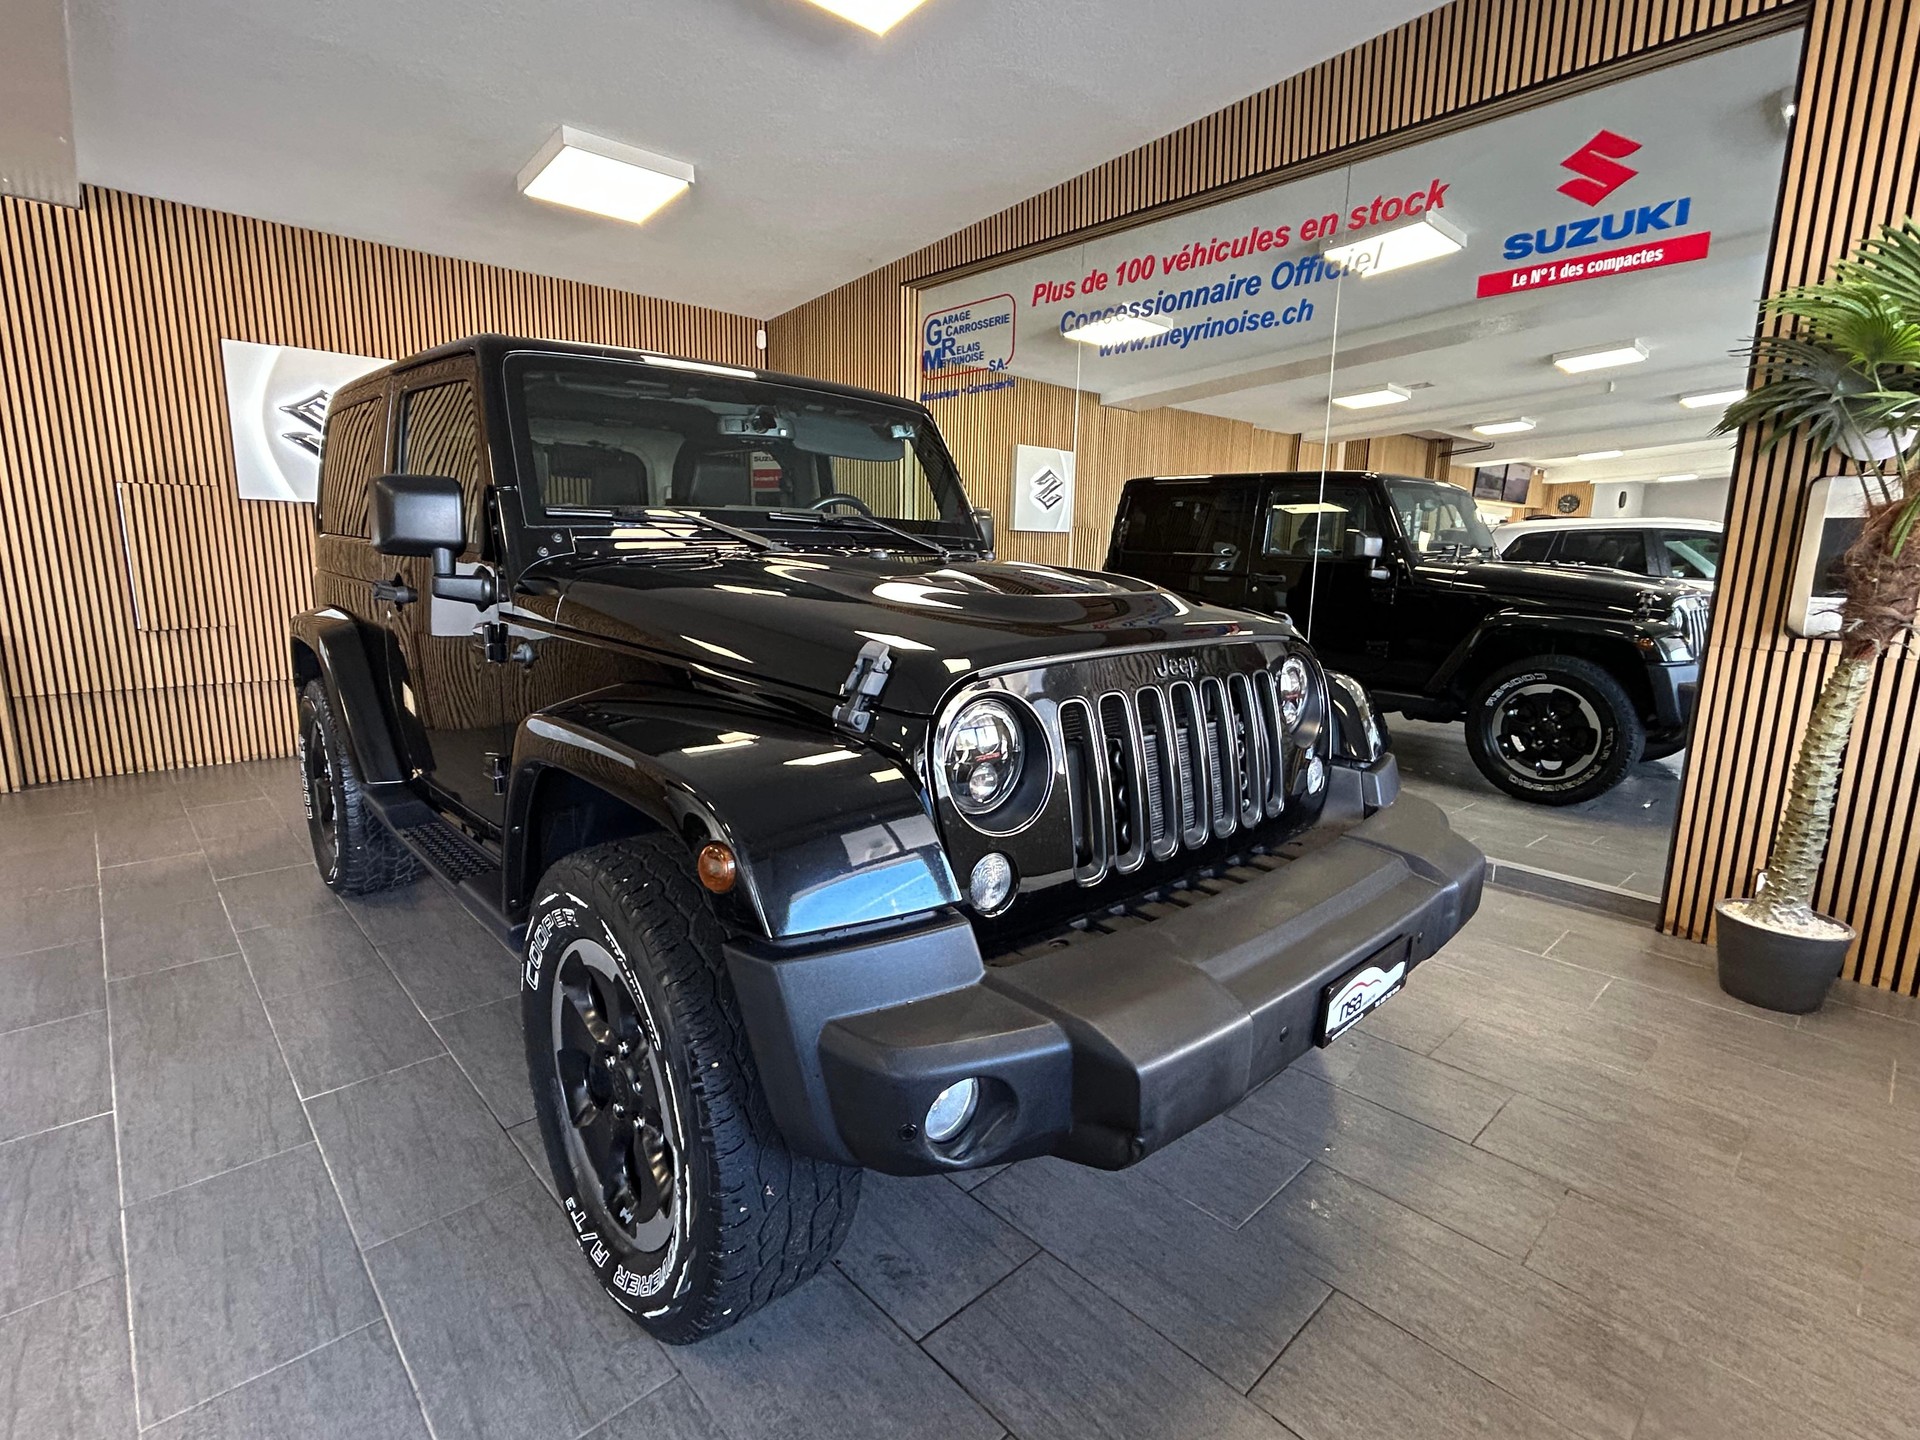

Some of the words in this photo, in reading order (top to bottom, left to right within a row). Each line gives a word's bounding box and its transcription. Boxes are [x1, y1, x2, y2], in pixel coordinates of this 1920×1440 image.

[1031, 280, 1076, 307] Plus
[1081, 269, 1108, 294] de
[1116, 255, 1155, 286] 100
[1162, 226, 1291, 275] véhicules
[1300, 213, 1339, 241] en
[1348, 178, 1450, 231] stock
[1503, 197, 1691, 260] SUZUKI
[1271, 242, 1384, 290] Officiel
[1511, 272, 1527, 288] Le
[1560, 261, 1584, 279] des
[1587, 247, 1664, 274] compactes
[926, 310, 971, 346] GARAGE
[945, 313, 1010, 337] CARROSSERIE
[942, 337, 981, 359] RELAIS
[1153, 654, 1198, 679] Jeep
[526, 908, 579, 991] COOPER
